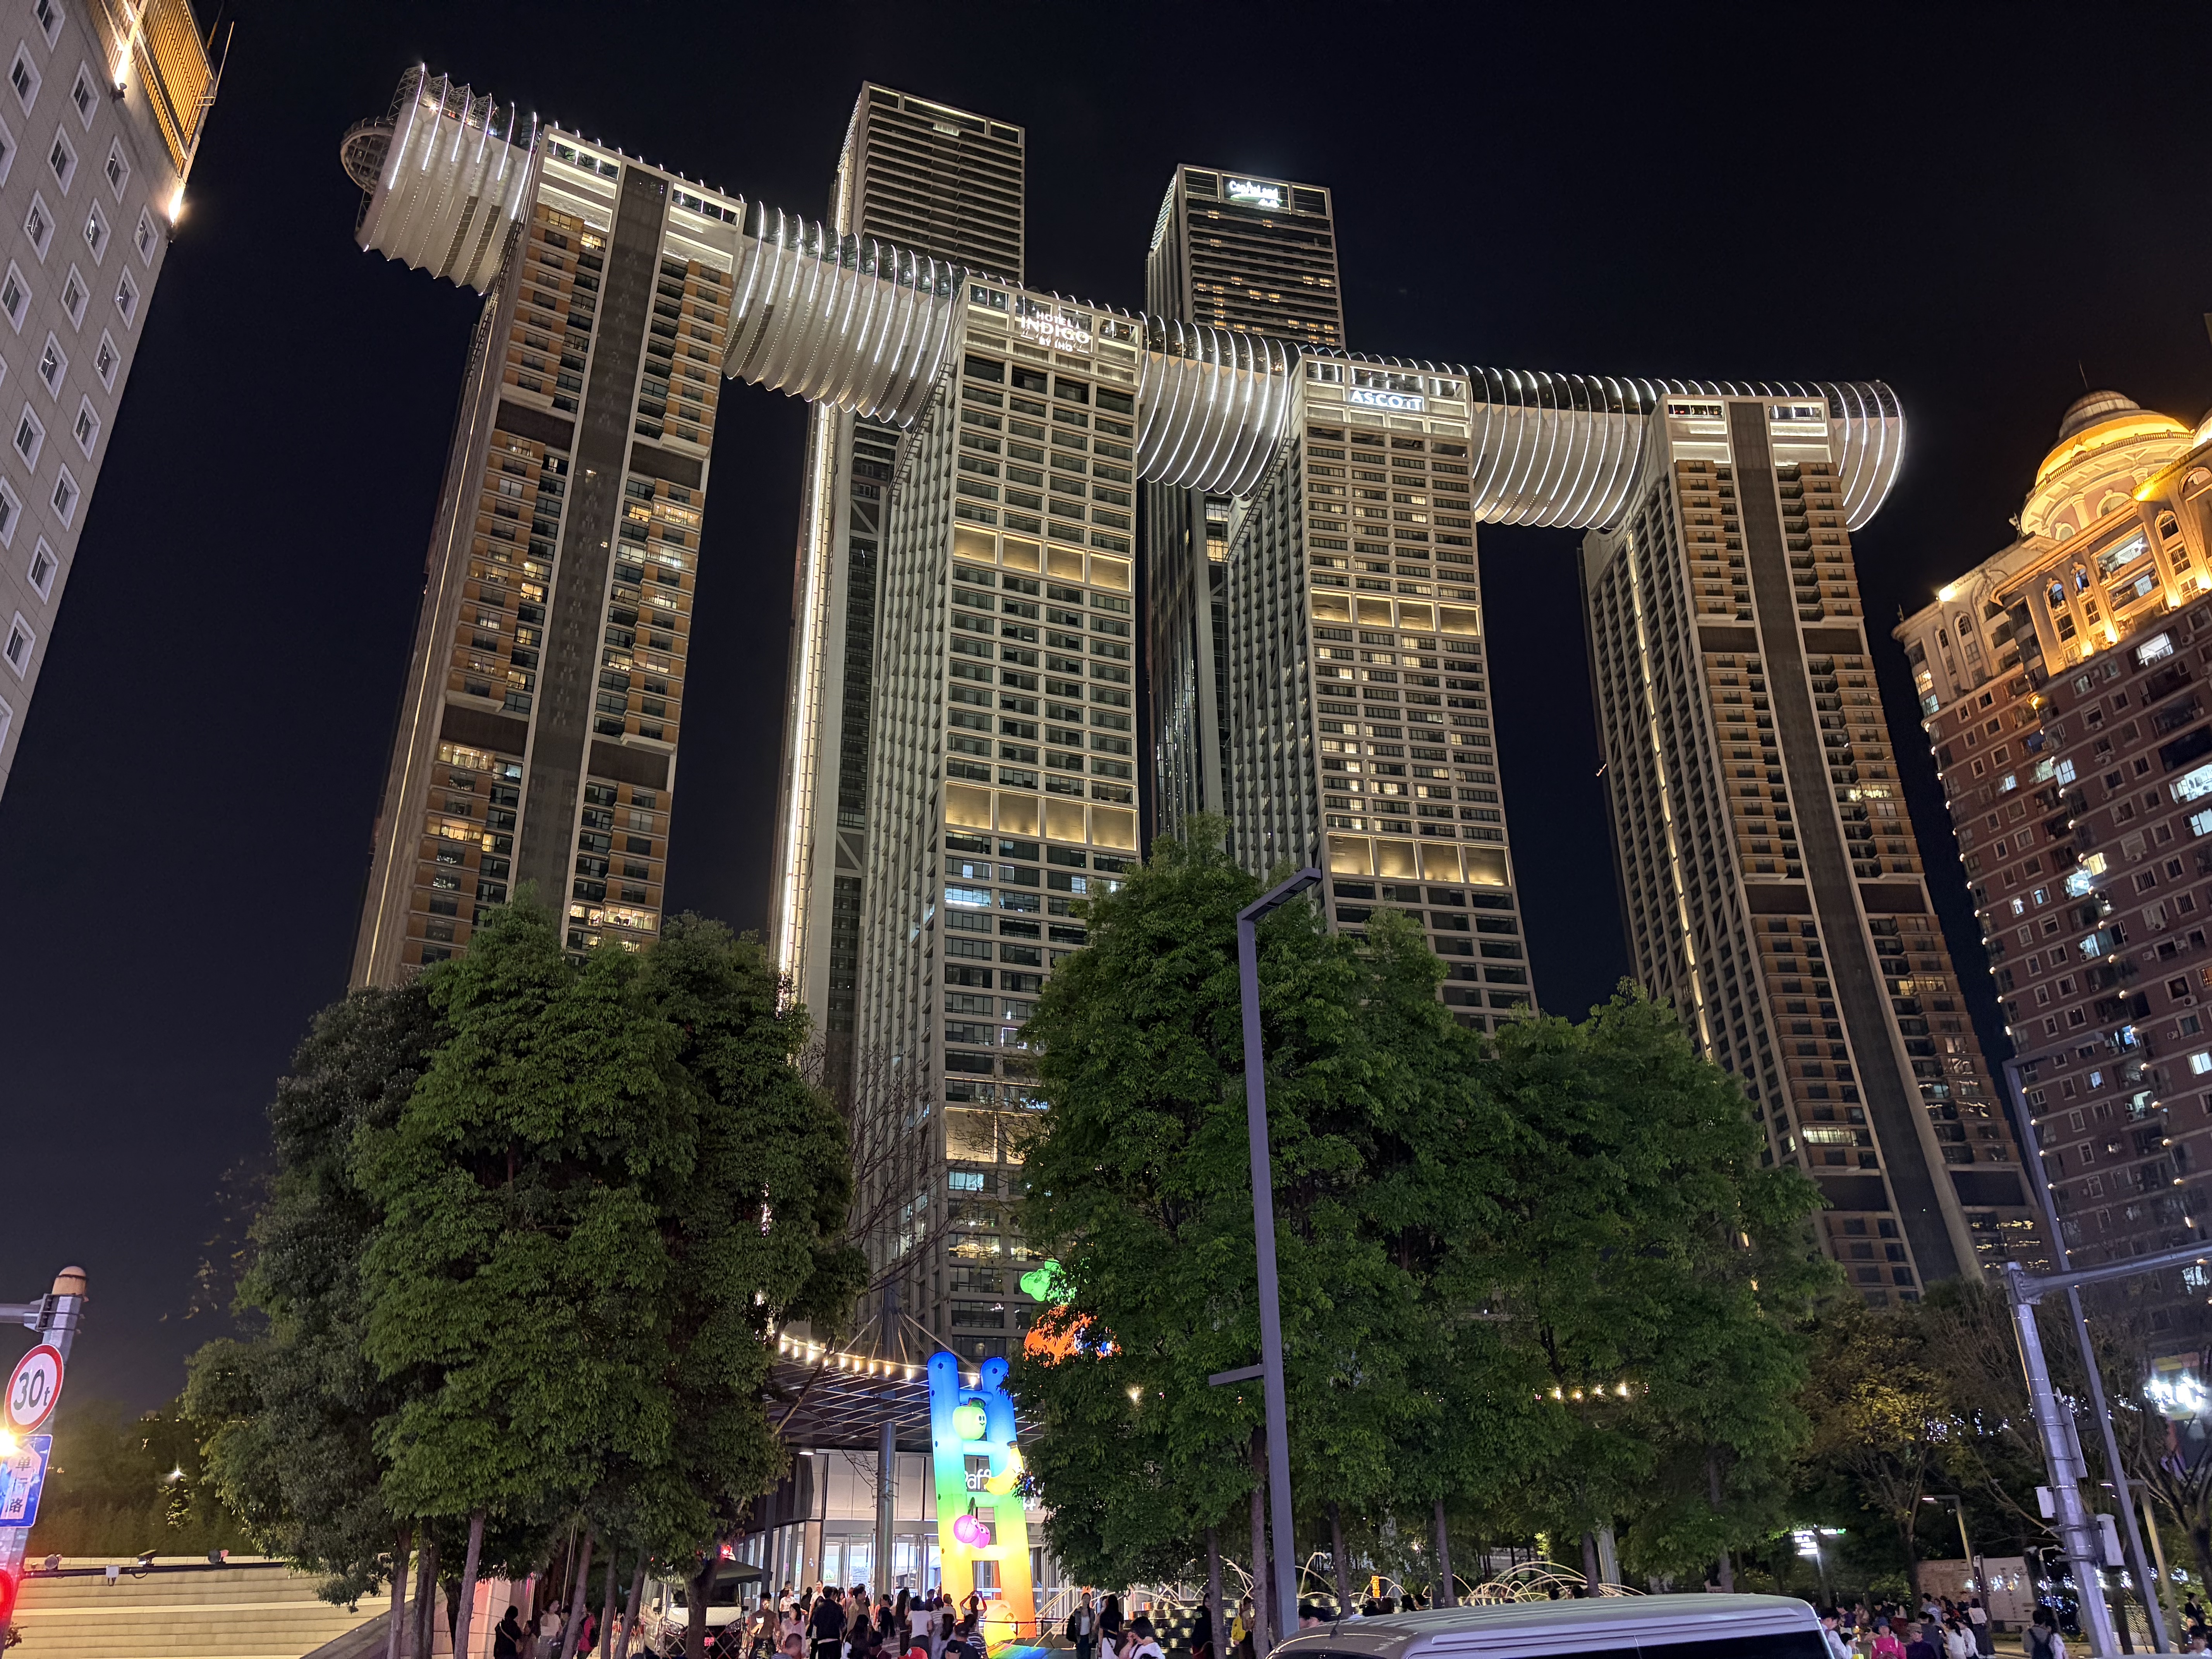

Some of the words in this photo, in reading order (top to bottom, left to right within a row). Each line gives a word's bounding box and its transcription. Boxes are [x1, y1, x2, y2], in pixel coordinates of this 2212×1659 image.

[1021, 315, 1089, 343] INDIGO
[1036, 310, 1073, 328] HOTEL
[1039, 336, 1051, 346] BY
[14, 1369, 50, 1410] 30t
